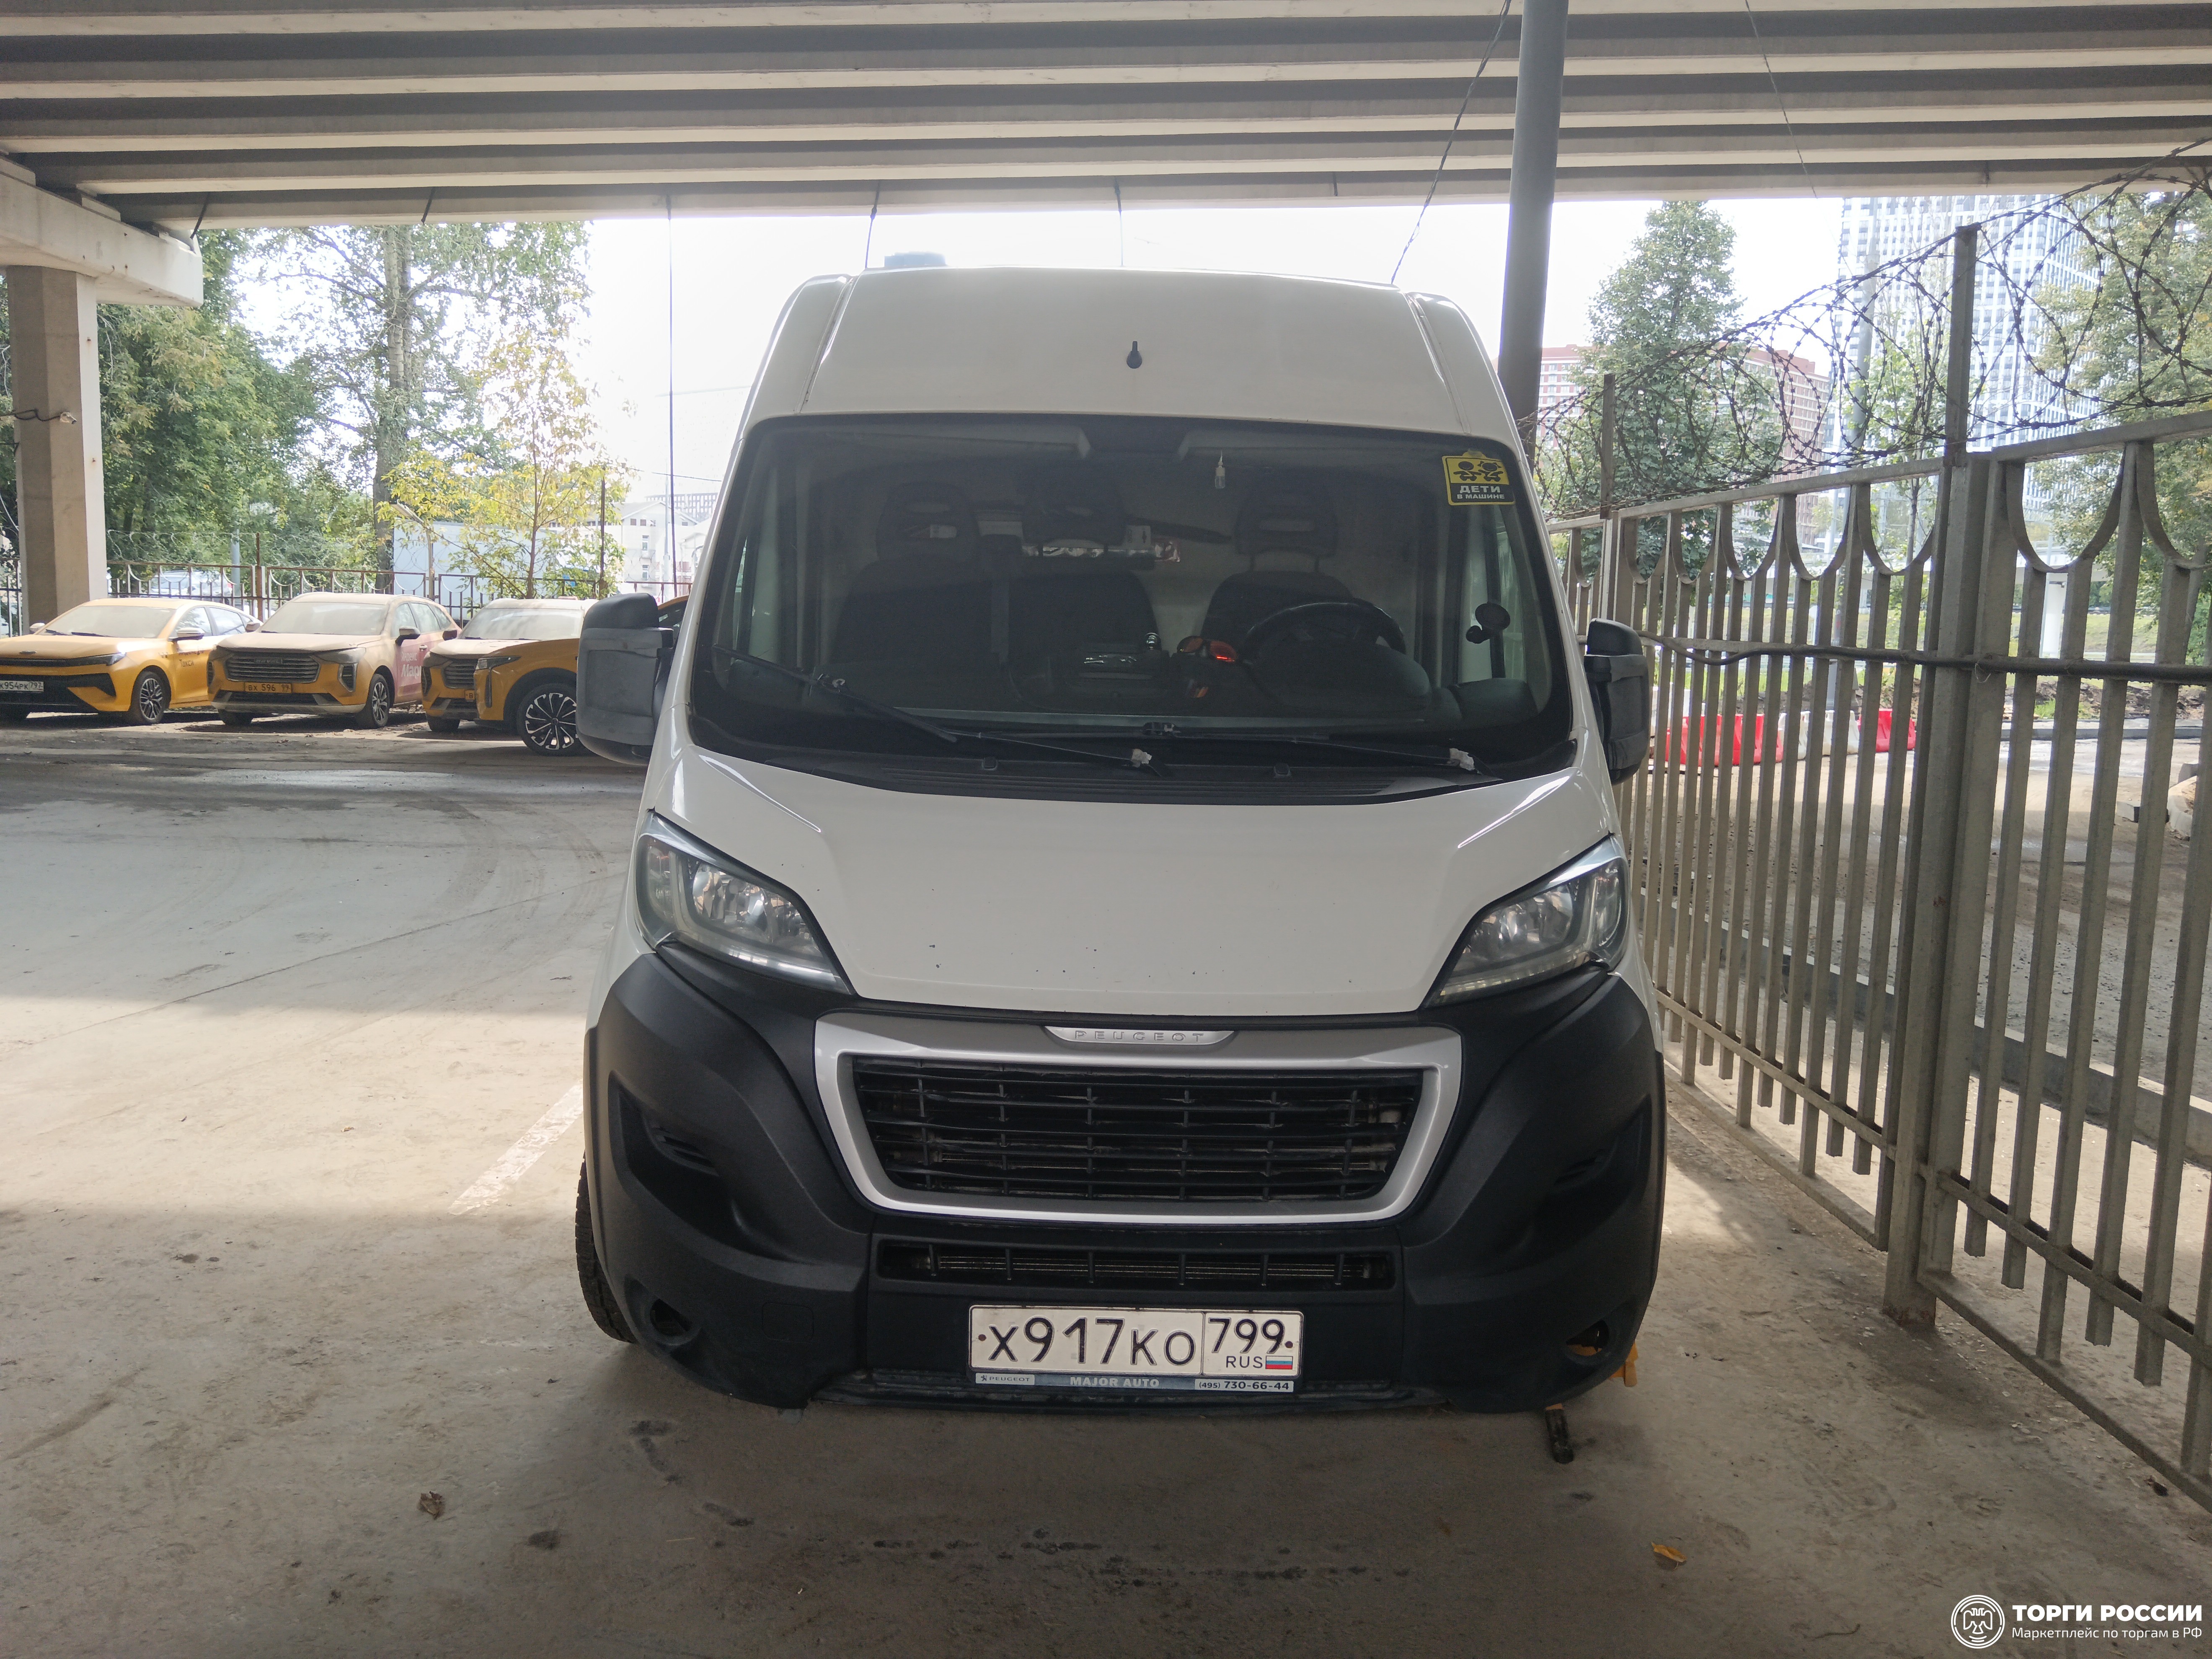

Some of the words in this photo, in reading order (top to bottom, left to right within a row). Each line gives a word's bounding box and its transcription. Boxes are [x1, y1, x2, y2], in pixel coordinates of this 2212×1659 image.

[1460, 485, 1501, 494] ДЕТИ
[1075, 1030, 1204, 1042] PEUGEOT
[1208, 1317, 1285, 1354] 799
[1226, 1355, 1263, 1369] RUS
[1070, 1377, 1119, 1387] MAJOR
[1123, 1378, 1160, 1388] AUTO
[1224, 1381, 1289, 1390] 730-66-44
